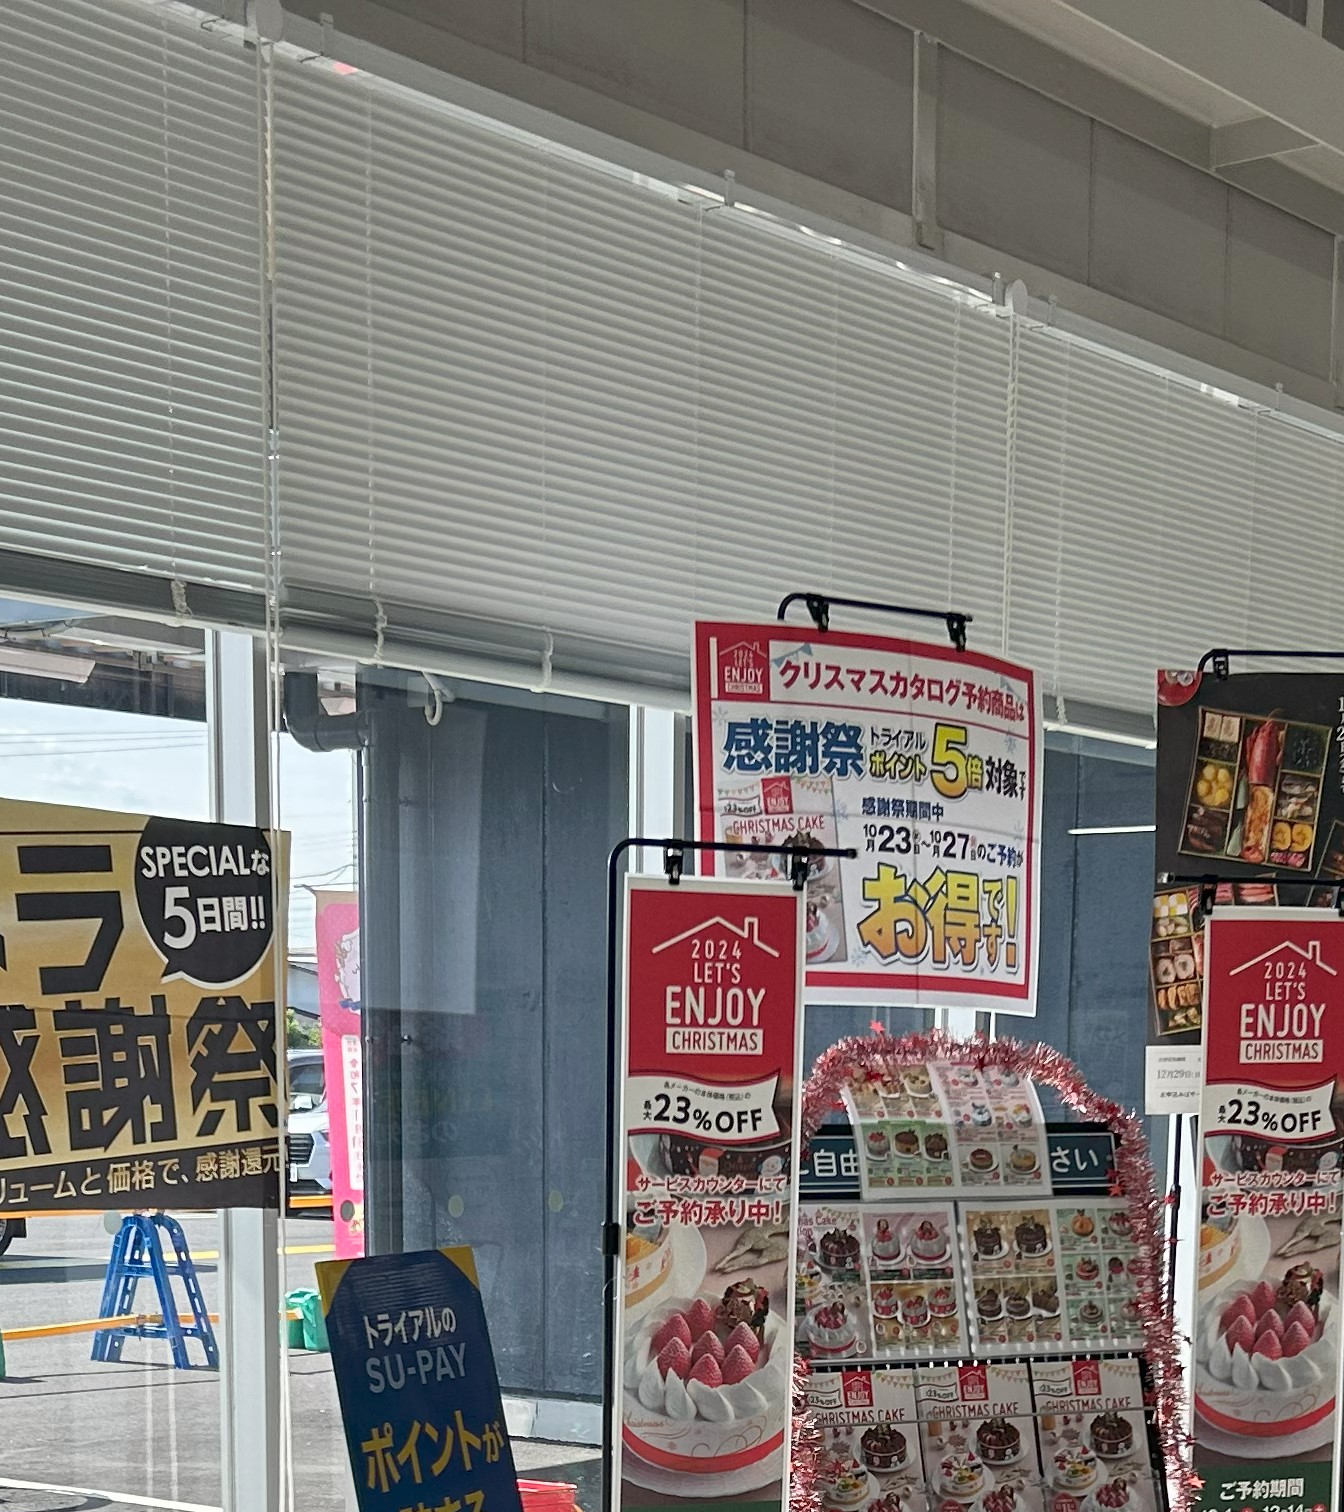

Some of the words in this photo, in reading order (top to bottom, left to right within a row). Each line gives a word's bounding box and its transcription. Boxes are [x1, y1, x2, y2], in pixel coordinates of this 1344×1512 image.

[724, 666, 763, 683] ENJOY
[779, 660, 1025, 722] クリスマスカタログ予約商品は
[723, 717, 865, 776] 感謝祭
[871, 727, 926, 750] トライアル
[870, 750, 927, 782] ポイント
[733, 817, 795, 835] CHRISTMAS
[798, 815, 826, 830] CAKE
[140, 845, 271, 878] SPECIALな
[162, 891, 267, 950] 5日間!!
[857, 862, 1019, 969] お得です!
[691, 939, 742, 960] 2024
[694, 962, 741, 985] LET'S
[1264, 961, 1307, 979] 2024
[1265, 981, 1306, 1001] LET'S
[666, 985, 766, 1027] ENJOY
[1240, 1003, 1326, 1038] ENJOY
[672, 1030, 758, 1053] CHRISTMAS
[1245, 1042, 1319, 1062] CHRISTMAS
[654, 1093, 762, 1133] 23%OFF
[1227, 1098, 1321, 1133] 23%OFF
[799, 1148, 860, 1177] 自由
[638, 1175, 786, 1193] サービスカウンターにて
[1211, 1171, 1340, 1188] サービスカウンターにて
[633, 1198, 782, 1227] ご予約承り中!
[1207, 1190, 1337, 1217] ご予約承り中!
[363, 1306, 456, 1349] トライアルの
[366, 1342, 467, 1394] SU-PAY
[816, 1411, 875, 1425] CHRISTMAS
[878, 1408, 905, 1423] CAKE
[933, 1404, 990, 1419] CHRISTMAS
[993, 1402, 1018, 1416] CAKE
[1046, 1399, 1104, 1413] CHRISTMAS
[1106, 1397, 1131, 1409] CAKE
[361, 1410, 505, 1494] ポイントが
[1220, 1478, 1304, 1501] ご予約期間
